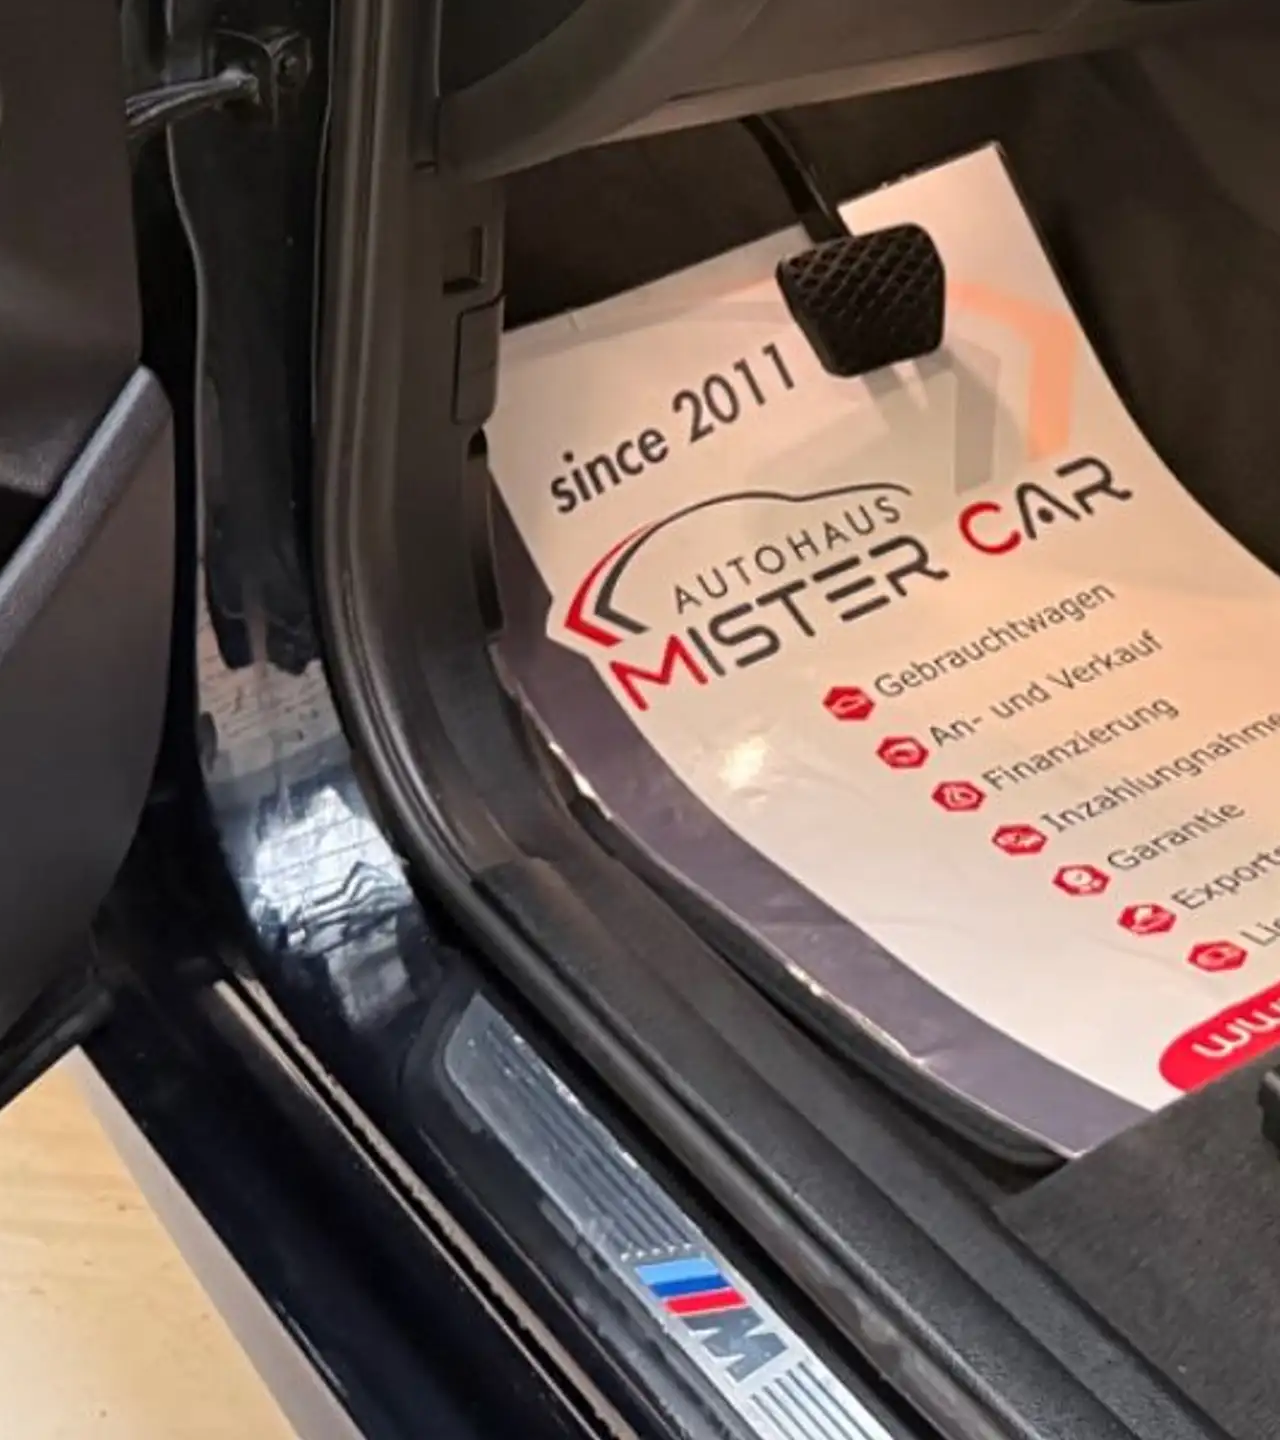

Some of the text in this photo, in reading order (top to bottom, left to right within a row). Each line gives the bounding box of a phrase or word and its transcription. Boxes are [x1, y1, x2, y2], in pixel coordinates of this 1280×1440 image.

[550, 342, 795, 515] since 2011
[608, 455, 1134, 713] MISTER CAR
[672, 495, 902, 614] AUTOHAUS
[873, 582, 1117, 699] Gebrauchtwagen
[928, 627, 1164, 748] An- und Verkauf
[980, 696, 1181, 792] Finanzierung
[1106, 801, 1247, 872] Garantie
